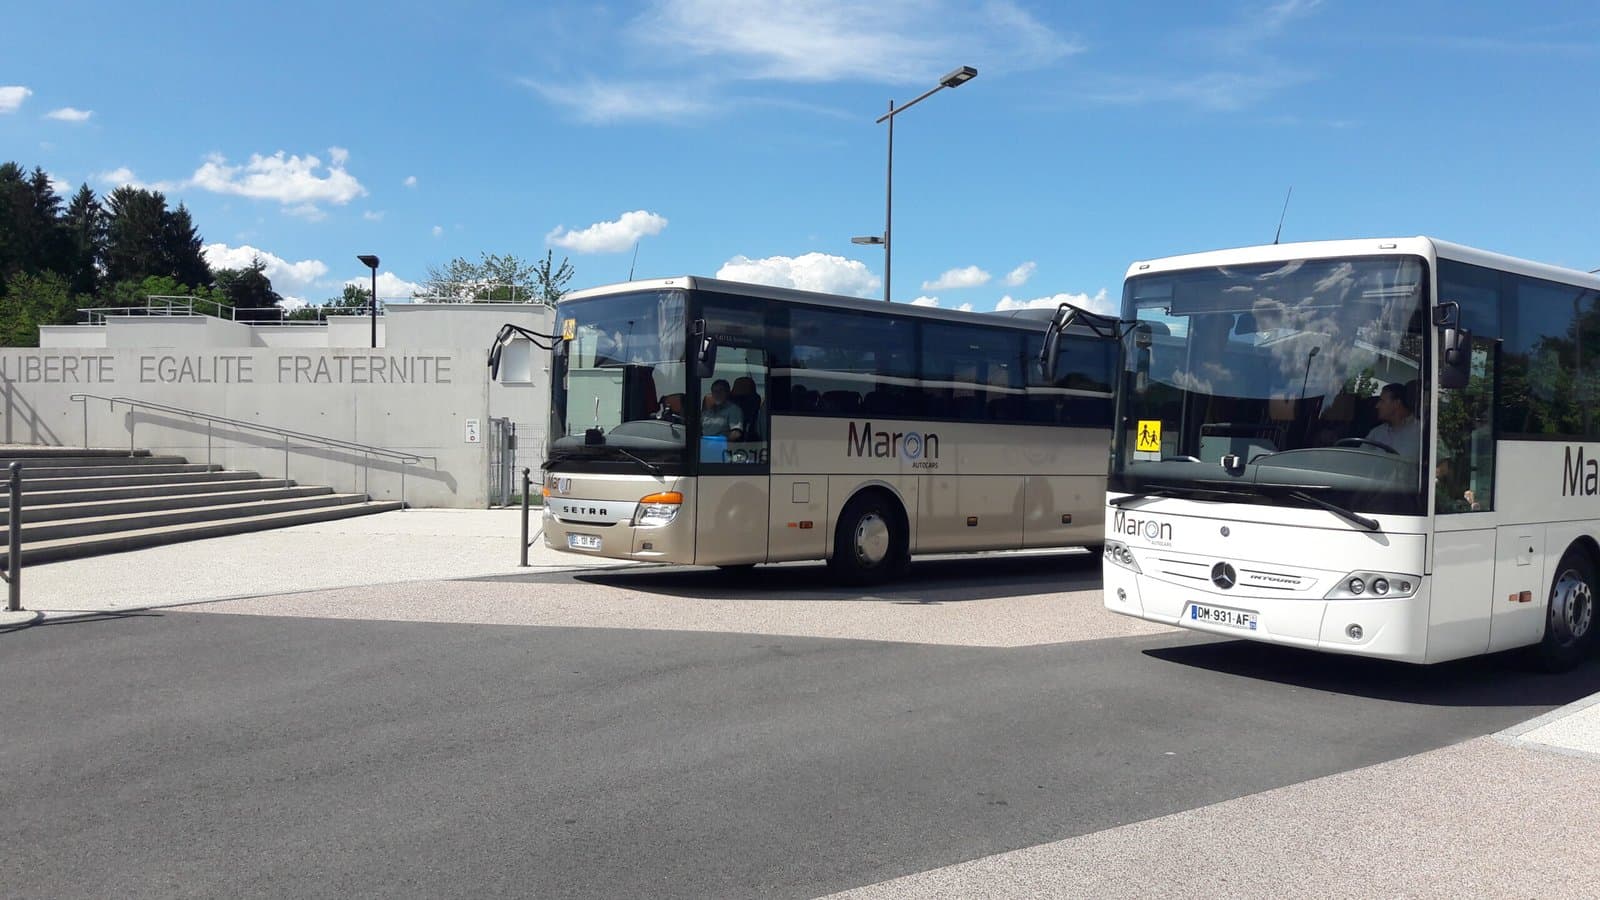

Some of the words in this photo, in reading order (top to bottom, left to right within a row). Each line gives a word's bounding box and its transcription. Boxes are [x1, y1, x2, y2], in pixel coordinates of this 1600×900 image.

[3, 355, 115, 383] LIBERTE
[139, 355, 253, 384] EGALITE
[277, 355, 452, 384] FRATERNITE
[847, 421, 939, 460] Maron
[911, 461, 939, 469] AUTOCARS
[1562, 445, 1600, 496] Ma
[563, 506, 607, 515] SETRA
[1113, 510, 1172, 541] Maron
[1250, 575, 1302, 585] INTOURO
[1197, 606, 1249, 626] DM-931-AF
